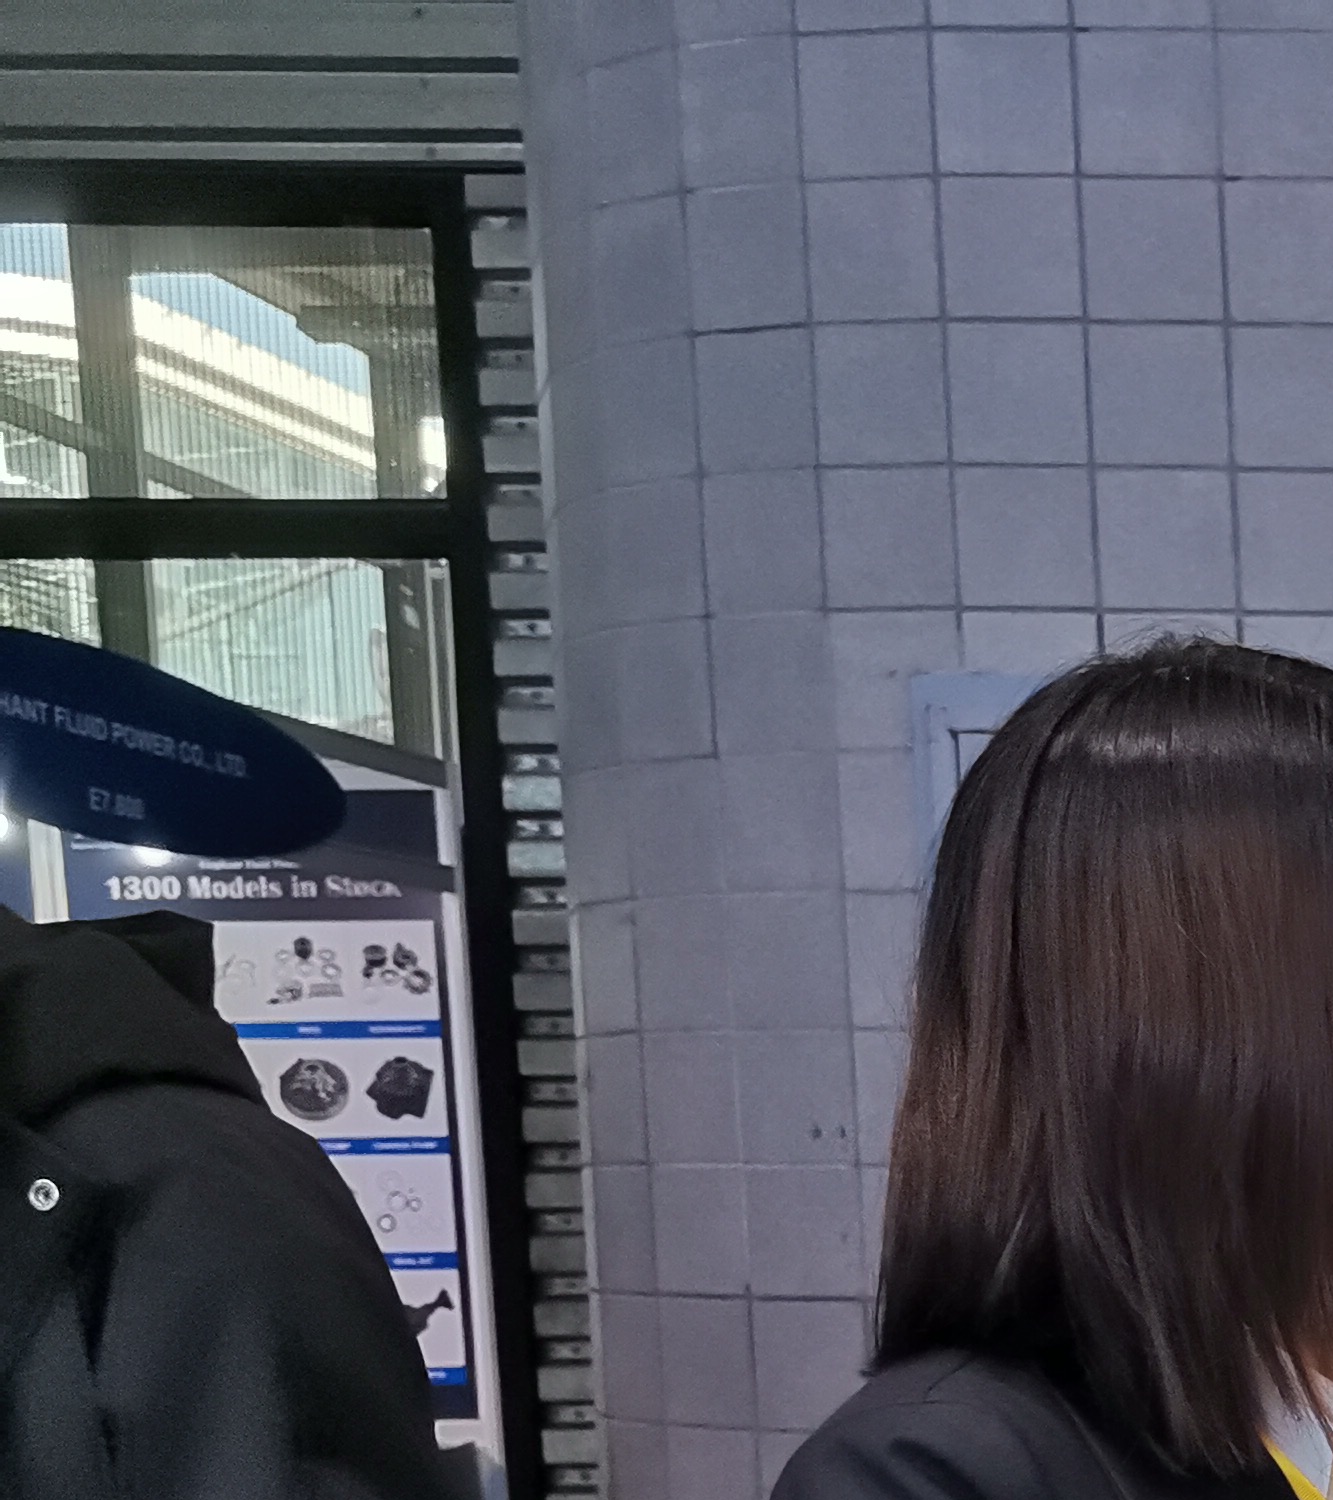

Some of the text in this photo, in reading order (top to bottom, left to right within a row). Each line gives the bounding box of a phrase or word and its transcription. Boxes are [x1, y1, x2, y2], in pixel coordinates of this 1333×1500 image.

[105, 875, 181, 901] 1300
[186, 874, 284, 900] Models
[290, 874, 318, 899] in
